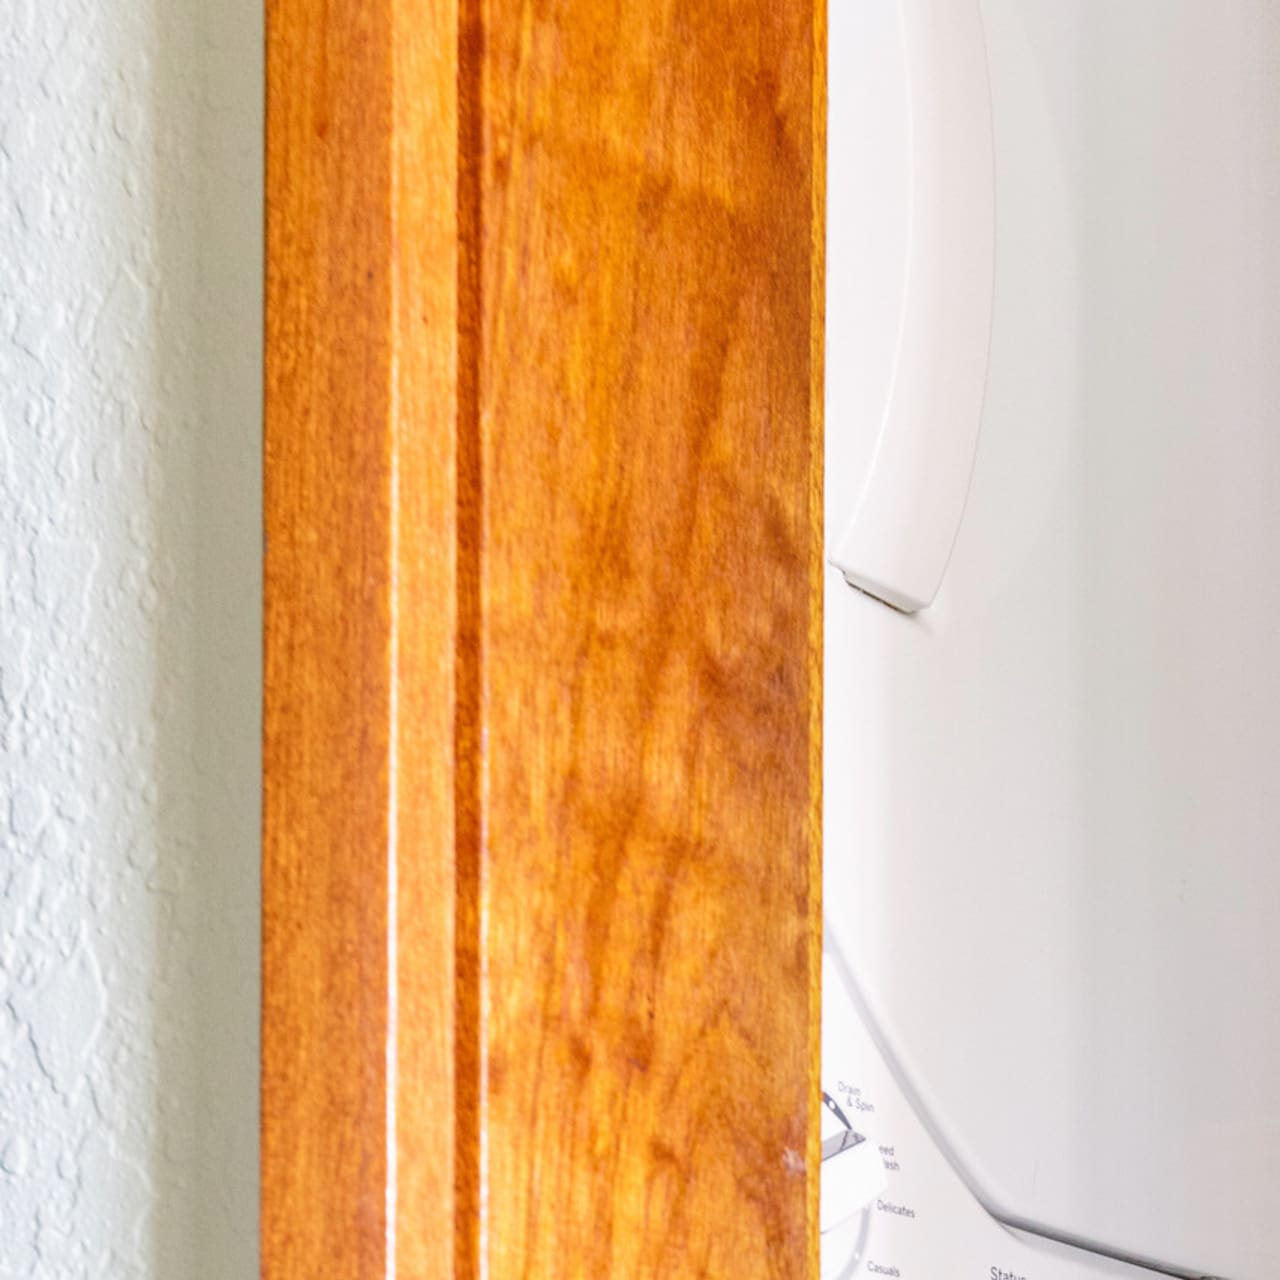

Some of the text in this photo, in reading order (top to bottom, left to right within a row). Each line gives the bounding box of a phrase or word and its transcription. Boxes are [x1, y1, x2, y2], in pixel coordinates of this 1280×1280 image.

[838, 1081, 862, 1097] Drain
[855, 1099, 875, 1113] Spin
[877, 1200, 915, 1218] Delicates
[867, 1260, 900, 1278] Casuals
